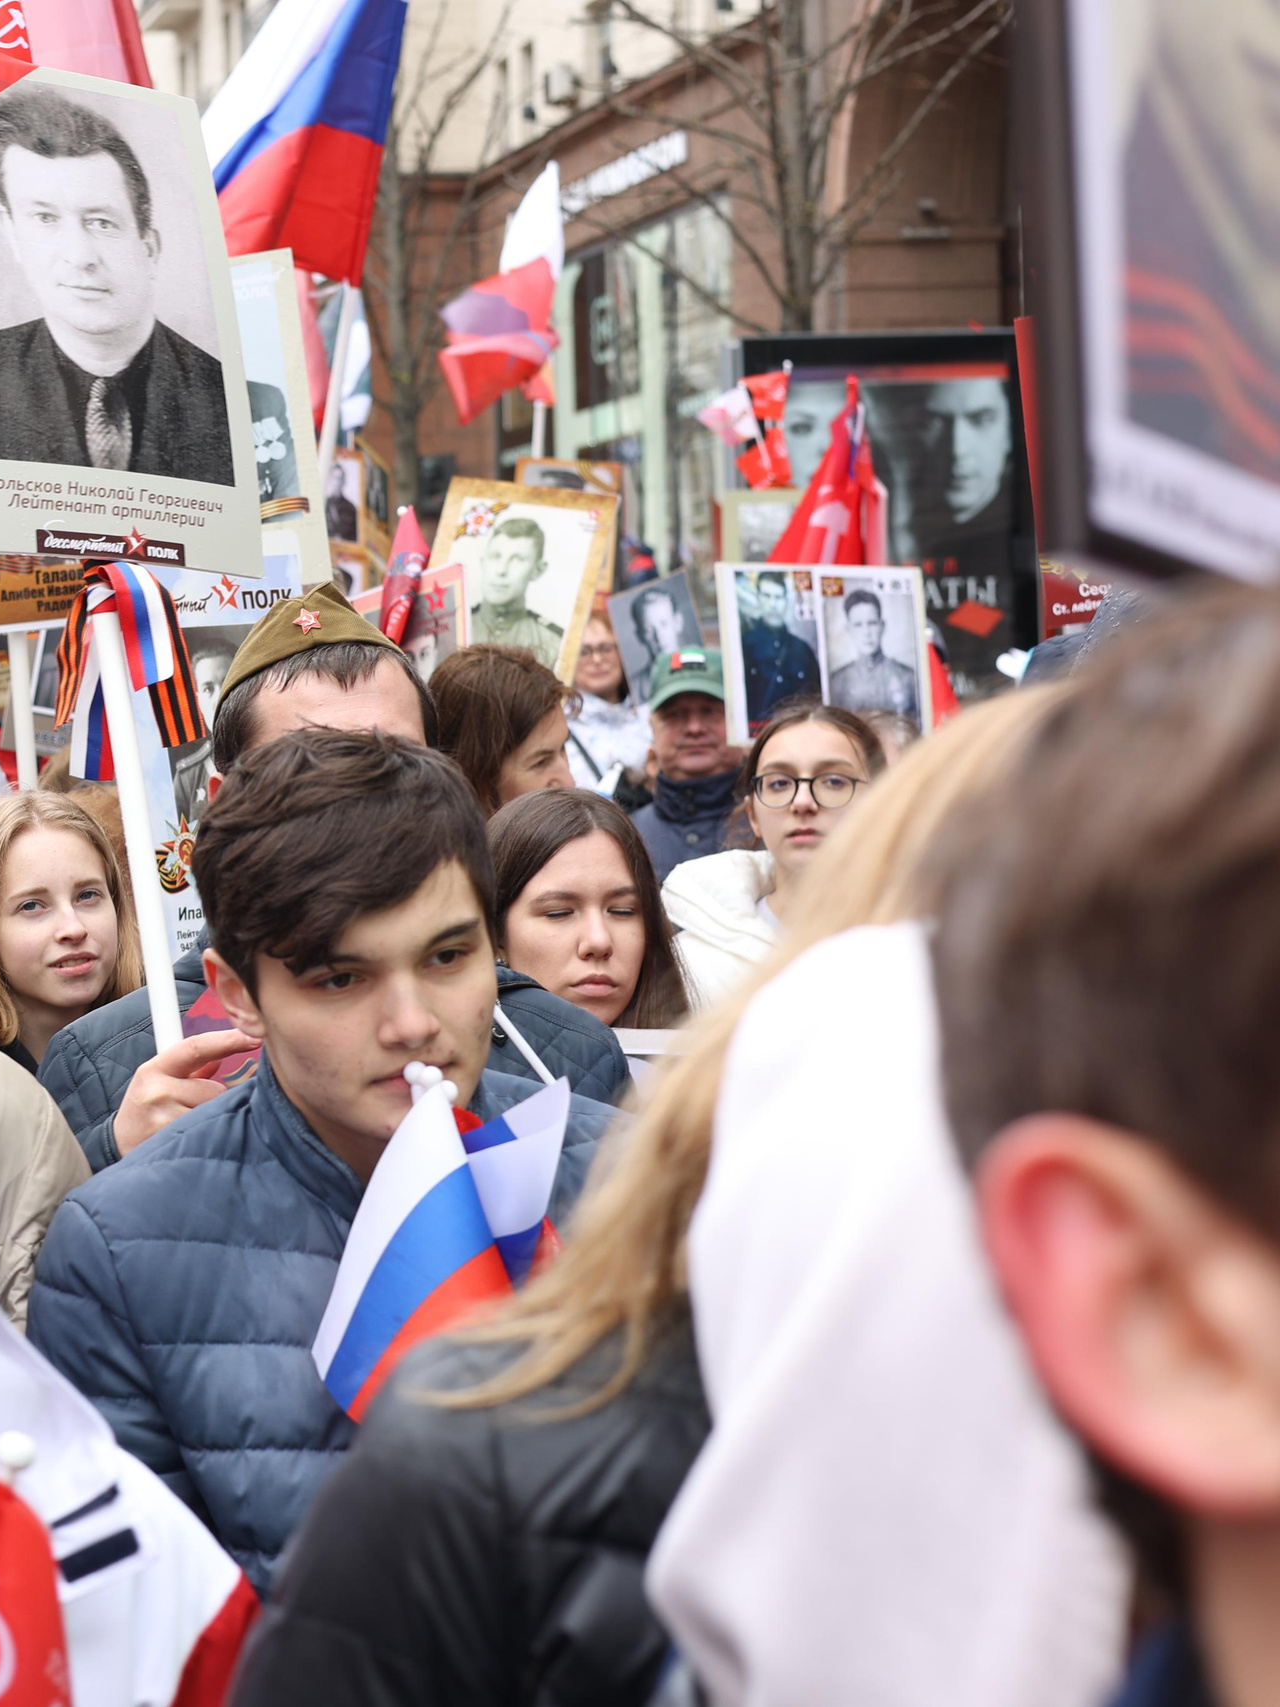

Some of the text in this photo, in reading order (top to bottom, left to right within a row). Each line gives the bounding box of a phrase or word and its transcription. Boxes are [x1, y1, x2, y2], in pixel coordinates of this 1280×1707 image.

[8, 493, 206, 528] Лейтенант артиллерии
[67, 481, 135, 501] Николай
[138, 488, 223, 514] Георгиевич
